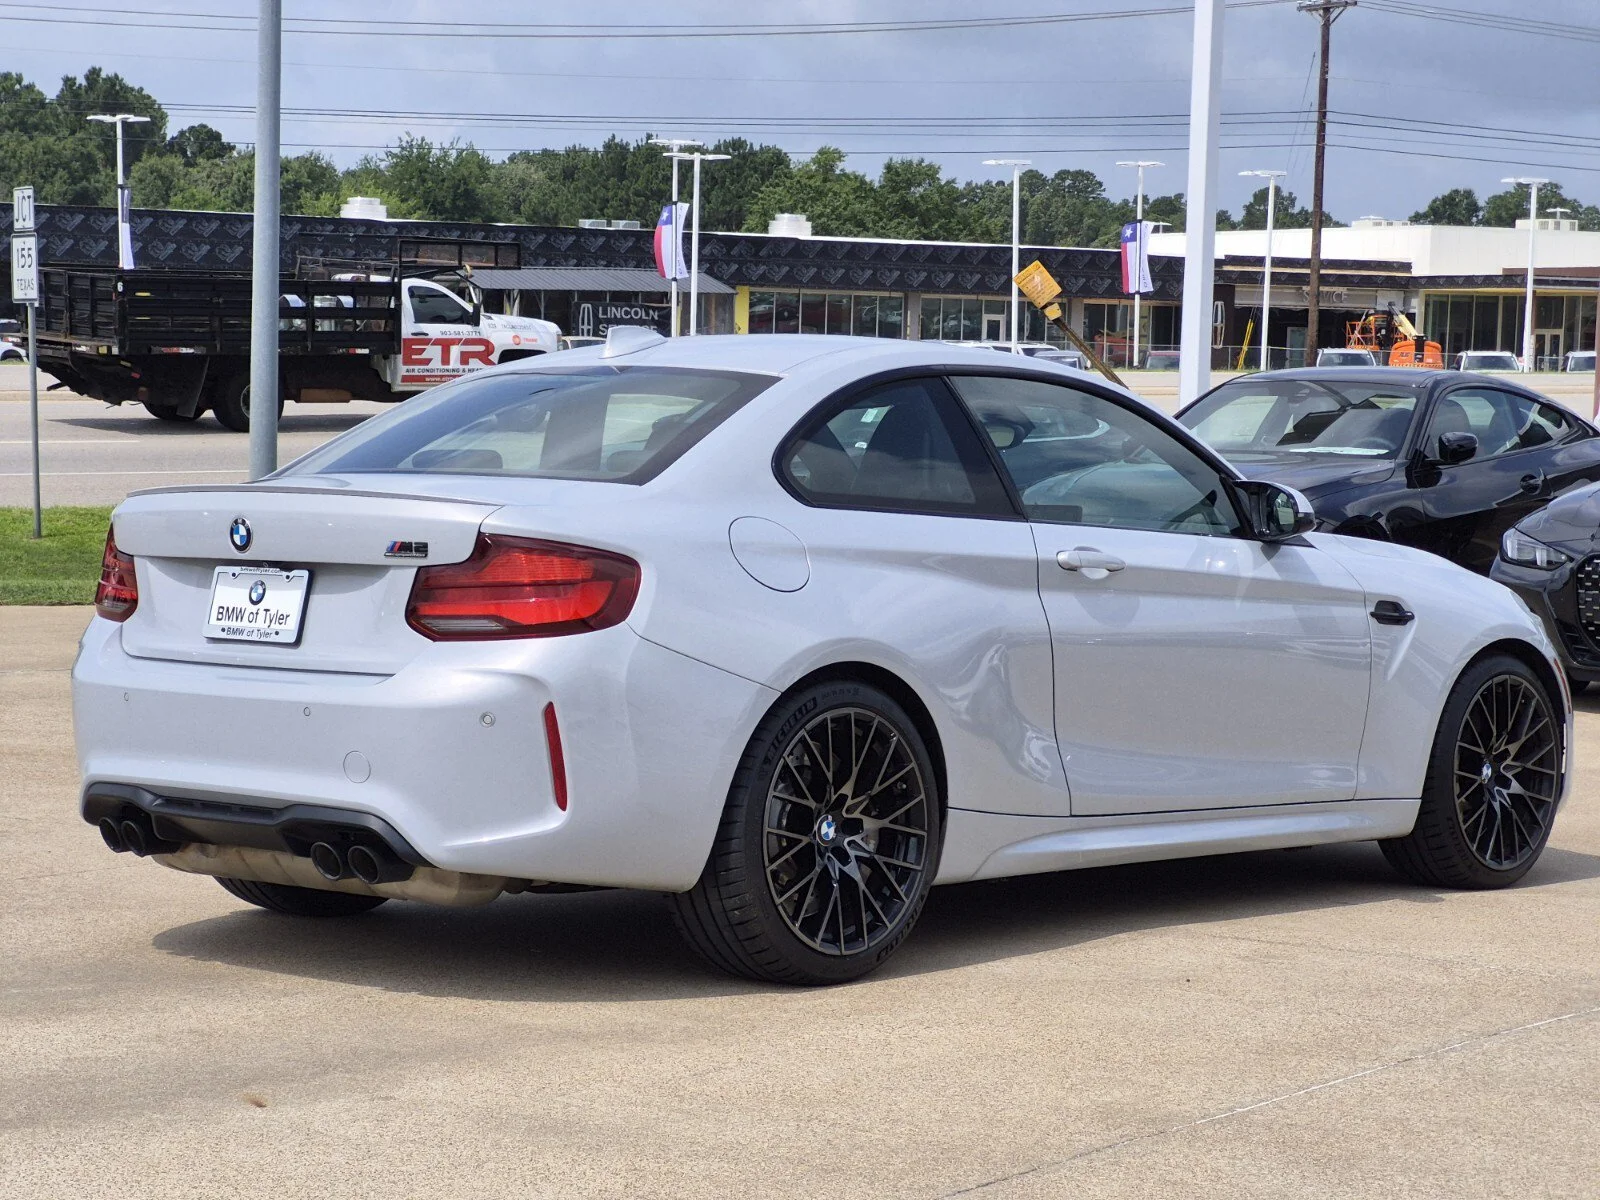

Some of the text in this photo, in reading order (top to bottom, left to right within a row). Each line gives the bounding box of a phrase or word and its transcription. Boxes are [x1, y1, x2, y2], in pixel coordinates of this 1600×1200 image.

[15, 195, 31, 223] JCT
[17, 247, 33, 268] 155
[17, 278, 34, 291] TEXAS
[117, 281, 124, 292] 6
[1303, 291, 1348, 303] SVICE
[598, 306, 659, 320] LINCOLN
[402, 337, 497, 366] ETR
[216, 605, 291, 629] BMW of Tyler
[226, 626, 274, 640] BMW of Tyler
